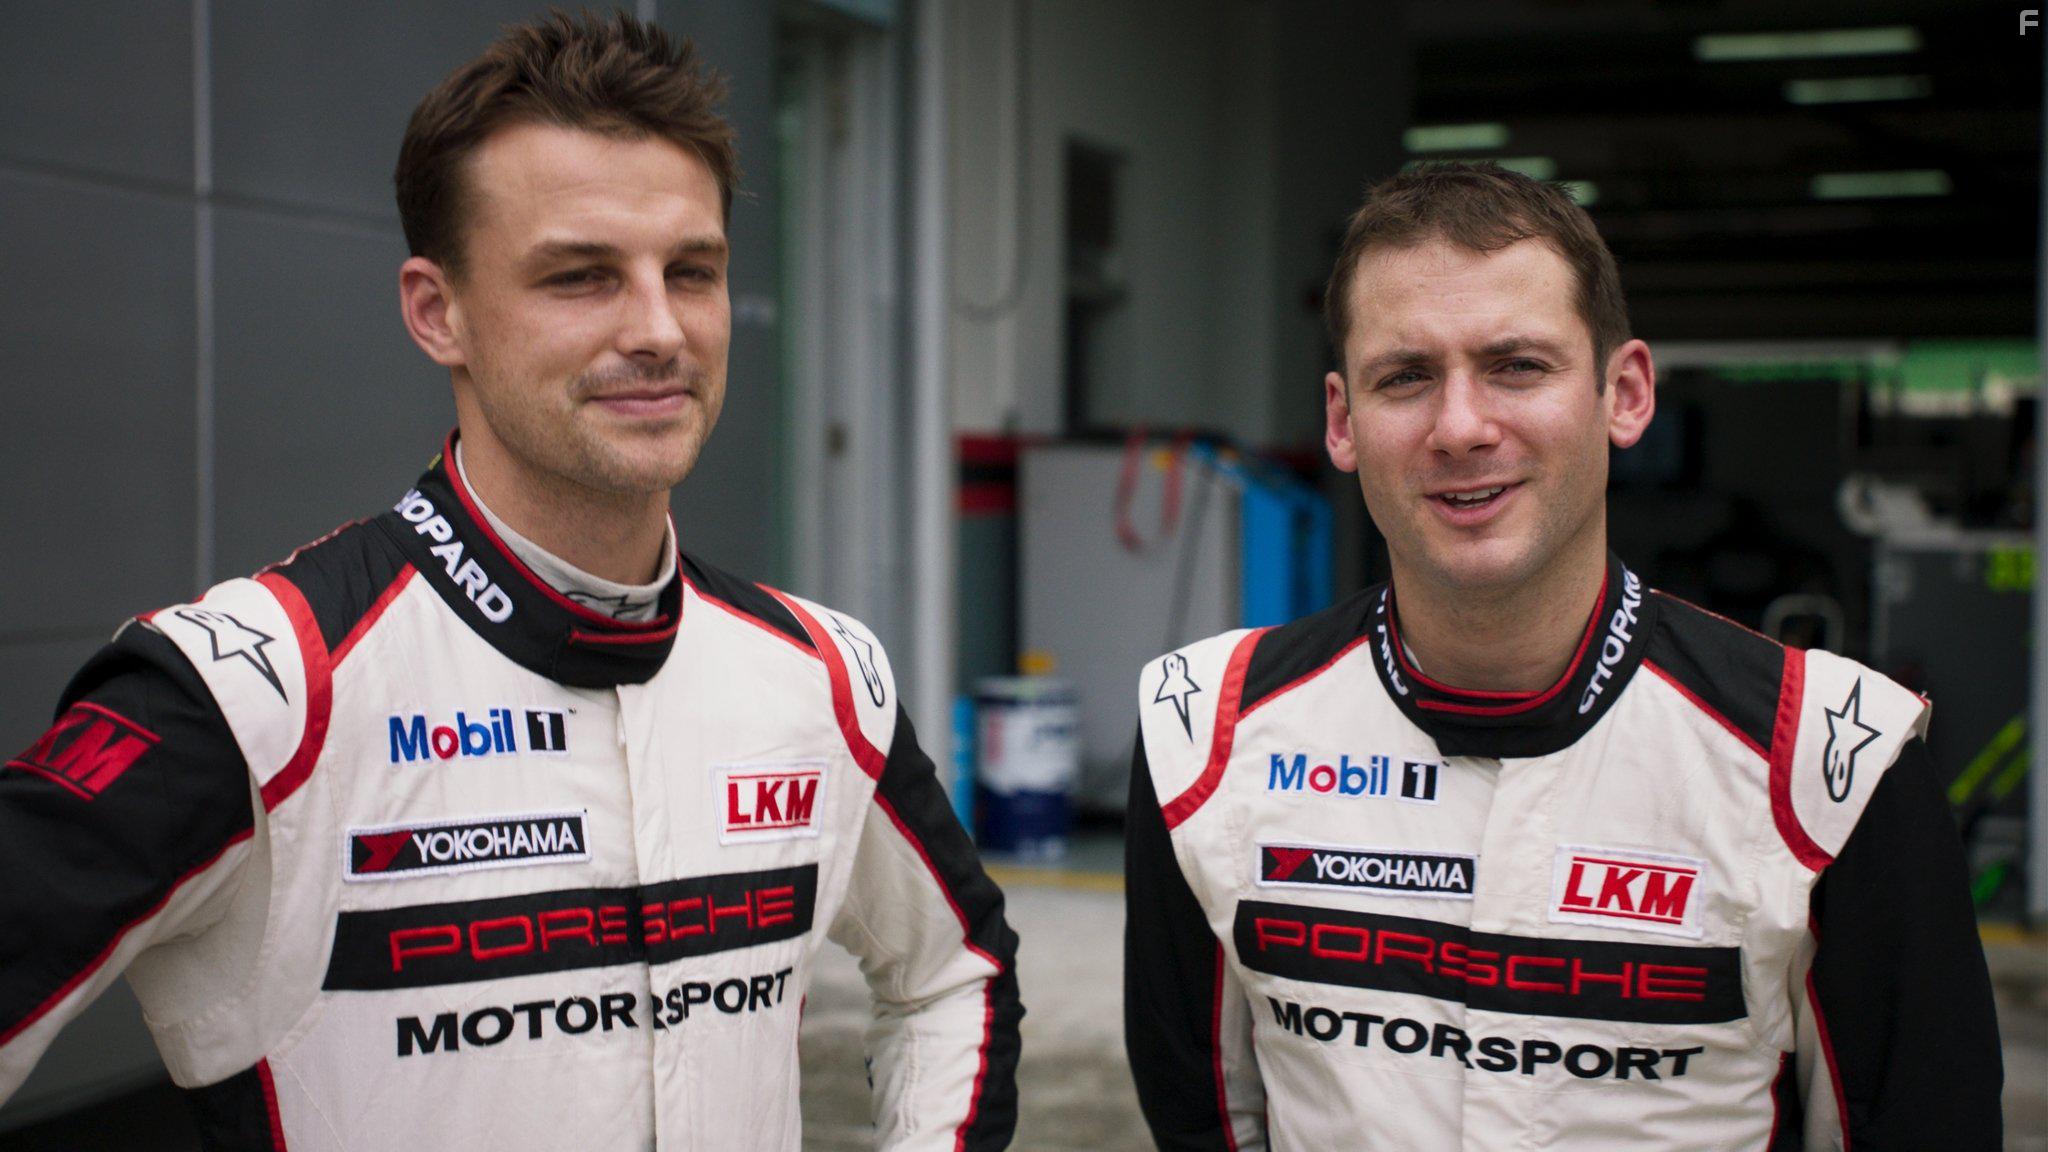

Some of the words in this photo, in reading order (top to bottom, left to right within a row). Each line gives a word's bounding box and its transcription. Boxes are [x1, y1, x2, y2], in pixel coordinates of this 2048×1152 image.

[389, 708, 517, 763] Mobil
[727, 778, 819, 825] LKM
[1268, 753, 1389, 796] Mobil
[412, 821, 579, 864] YOKOHAMA
[1312, 853, 1468, 890] YOKOHAMA
[1562, 863, 1695, 918] LKM
[389, 885, 795, 973] PORSCHE
[1254, 917, 1709, 1002] PORSCHE
[1267, 996, 1705, 1080] MOTORSPORT
